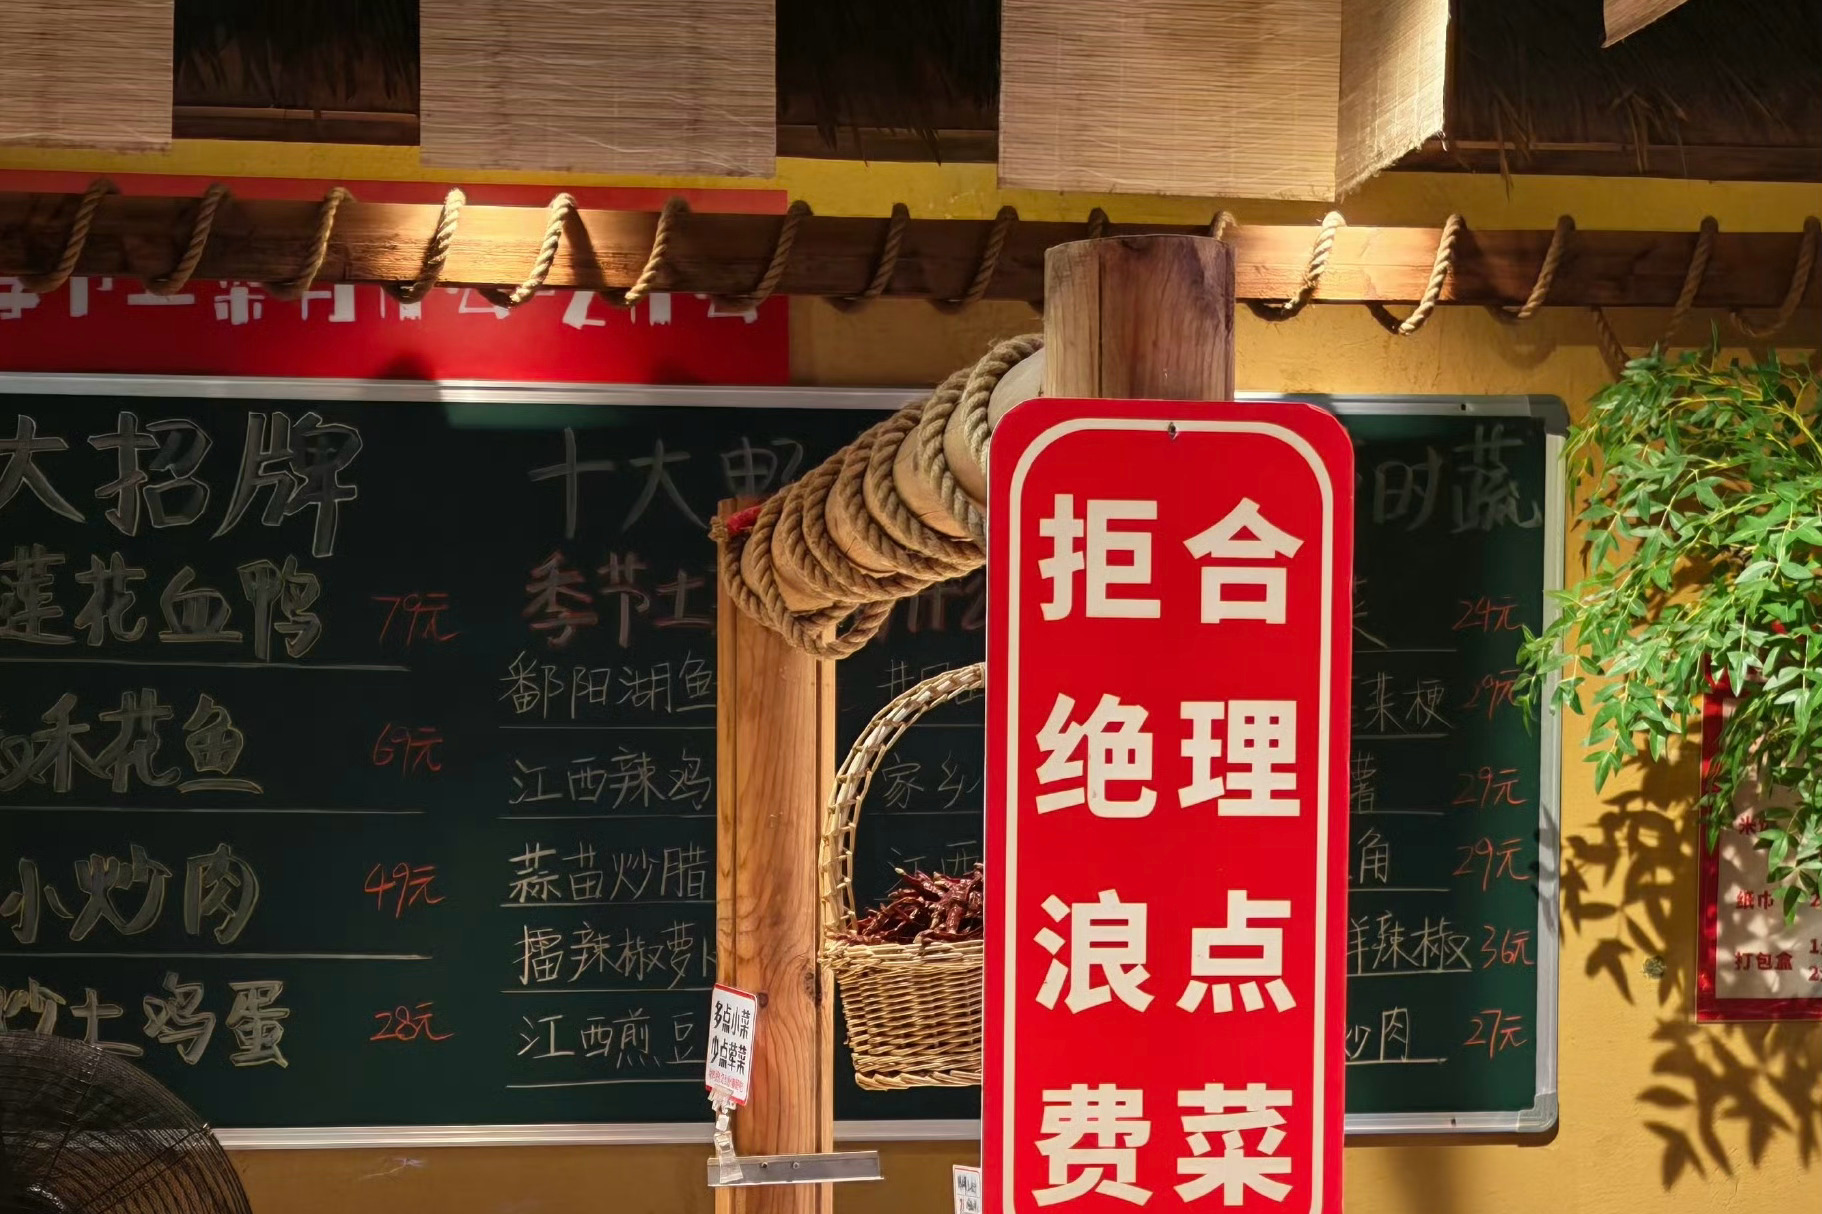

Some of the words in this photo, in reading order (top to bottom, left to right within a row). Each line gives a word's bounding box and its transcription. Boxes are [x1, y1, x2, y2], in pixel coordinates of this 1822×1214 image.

[0, 411, 363, 558] 大招牌
[372, 593, 460, 646] 79元
[520, 549, 717, 648] 季节土
[1452, 596, 1525, 633] 24元
[372, 722, 443, 775] 69元
[509, 746, 712, 811] 江西辣鸡
[877, 751, 982, 809] 家乡
[1453, 767, 1527, 808] 29元
[509, 841, 709, 902] 蒜苗炒腊
[1032, 493, 1161, 1208] 拒绝浪费
[1174, 497, 1304, 1207] 合理点菜
[1453, 838, 1530, 891] 29元
[0, 843, 260, 944] 小炒肉
[364, 863, 446, 918] 49元
[1736, 890, 1774, 910] 纸巾
[1480, 926, 1534, 968] 36元
[1735, 952, 1793, 971] 打包盒
[370, 1002, 454, 1041] 28元
[517, 1007, 707, 1069] 江西煎豆
[714, 1000, 751, 1039] 多点小菜
[1464, 1008, 1528, 1060] 27元
[711, 1035, 747, 1075] 少点荤菜
